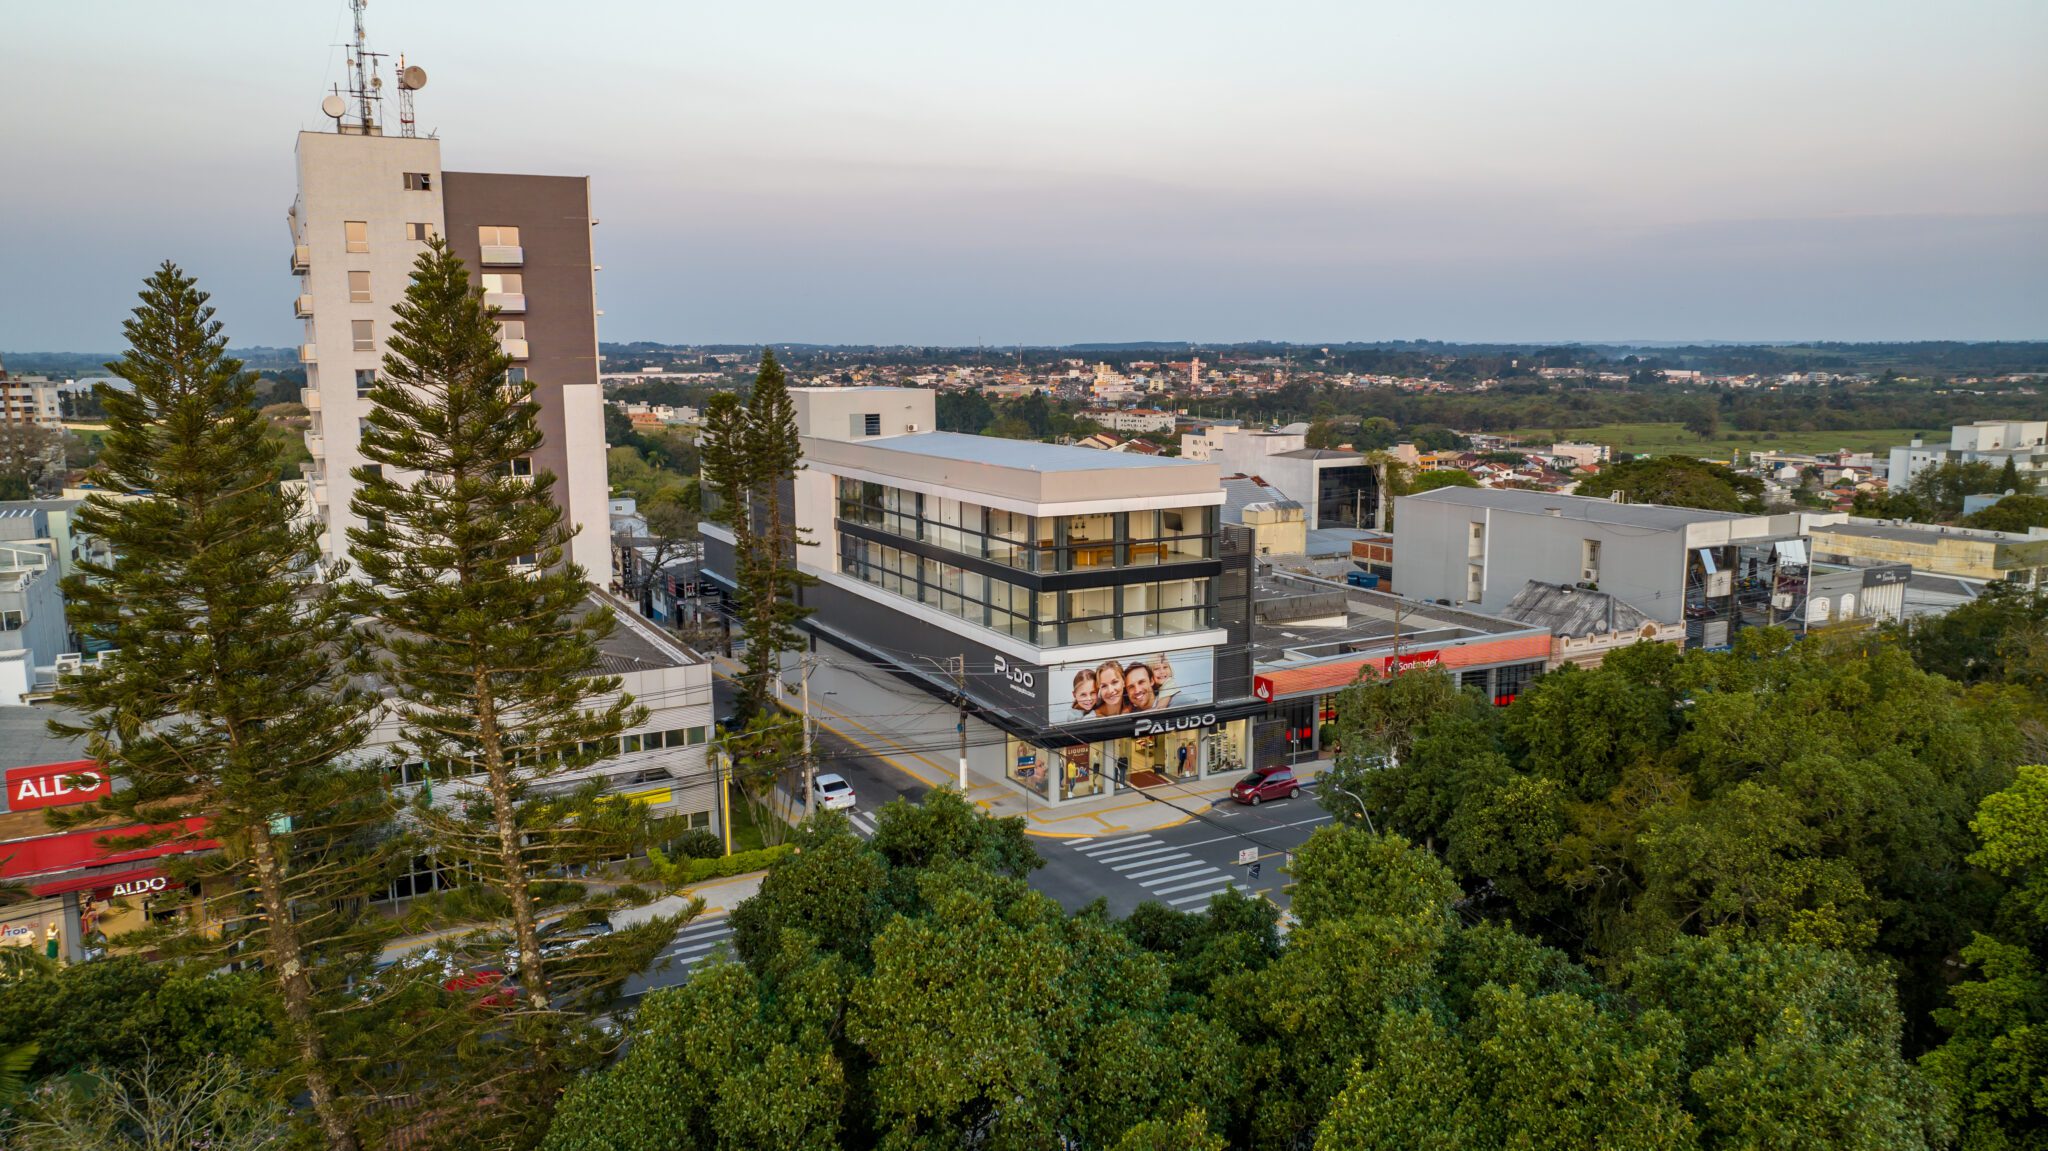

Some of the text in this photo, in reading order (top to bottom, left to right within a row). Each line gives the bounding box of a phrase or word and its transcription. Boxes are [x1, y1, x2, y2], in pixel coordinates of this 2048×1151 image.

[994, 654, 1034, 688] PLDO
[1134, 713, 1216, 737] PALUDO
[17, 771, 101, 801] ALDO
[112, 876, 167, 897] ALDO
